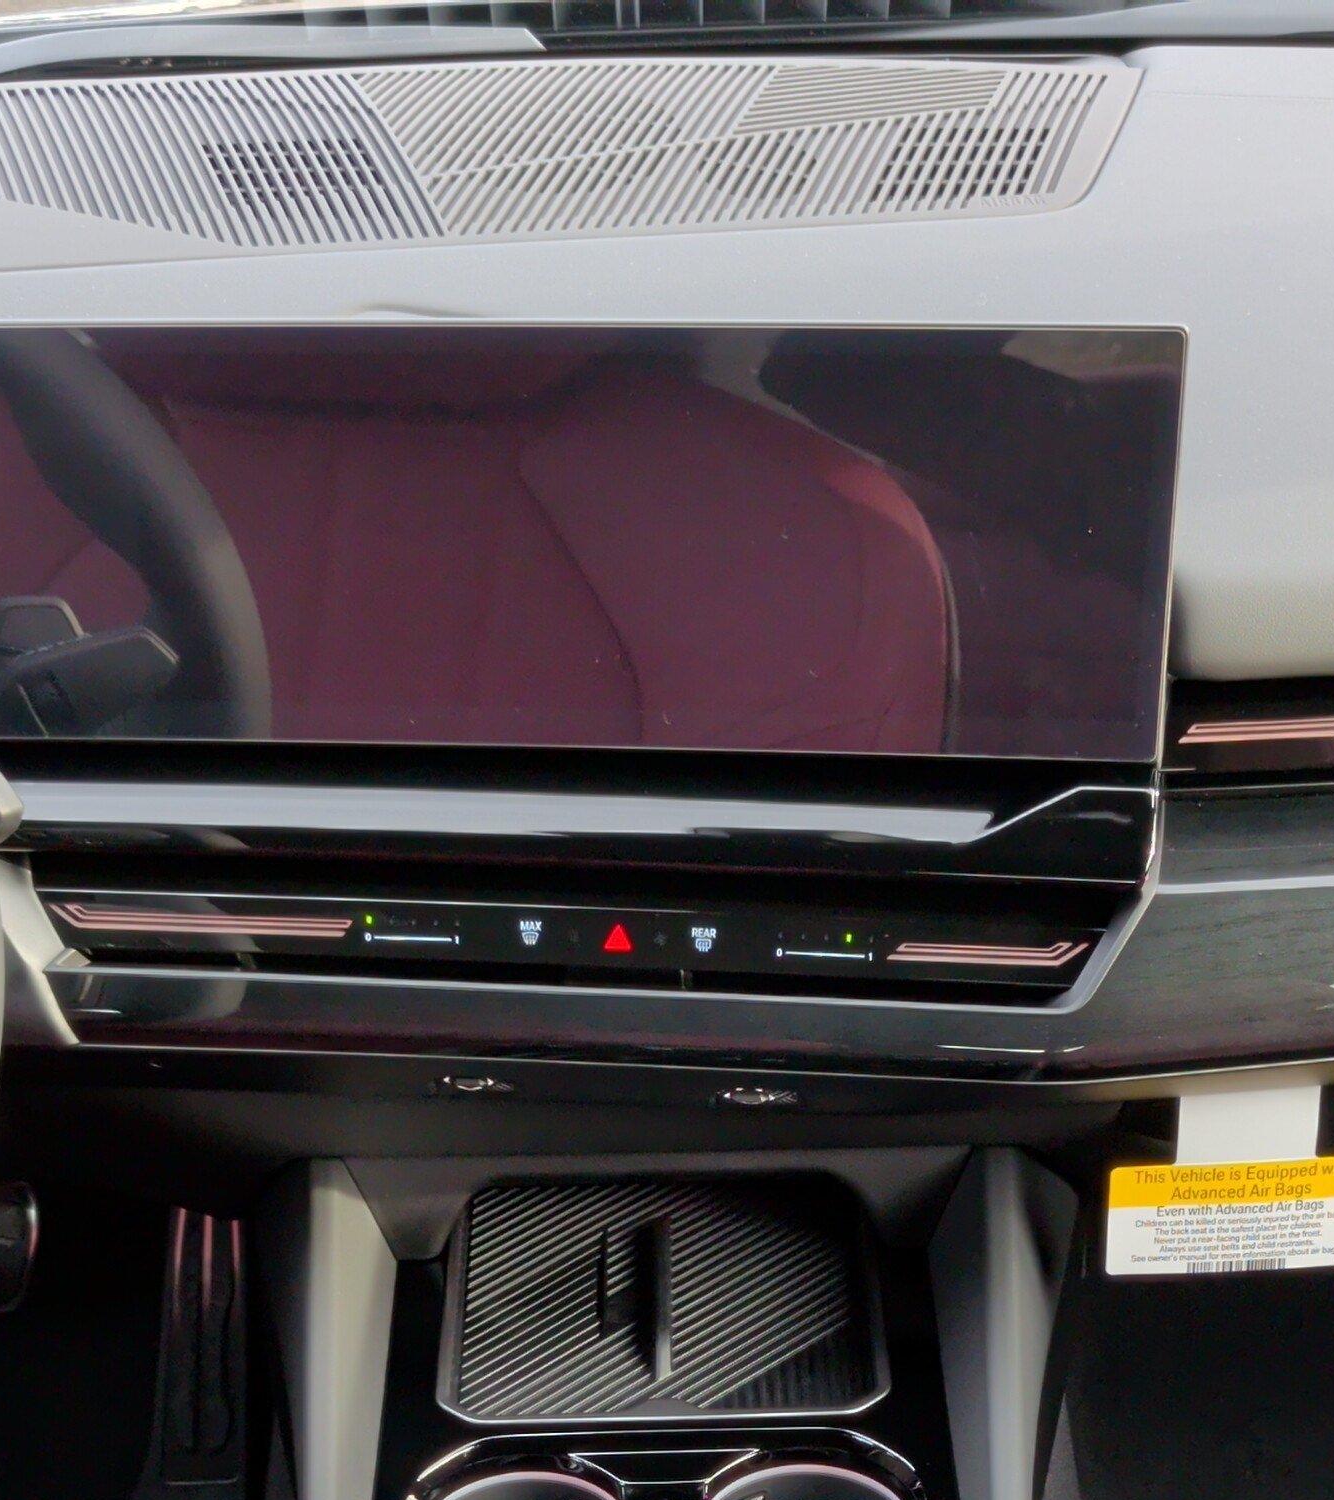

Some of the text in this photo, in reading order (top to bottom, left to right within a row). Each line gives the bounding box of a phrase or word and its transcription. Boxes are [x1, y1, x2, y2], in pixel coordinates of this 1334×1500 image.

[520, 920, 542, 932] MAX
[691, 928, 717, 939] REAR
[1135, 1170, 1165, 1184] This
[1170, 1168, 1225, 1182] Vehicle
[1229, 1167, 1241, 1180] is
[1247, 1163, 1317, 1181] Equipped
[1171, 1183, 1312, 1200] Advanced Air Bags
[1157, 1200, 1324, 1217] Even with Advanced Air Bags
